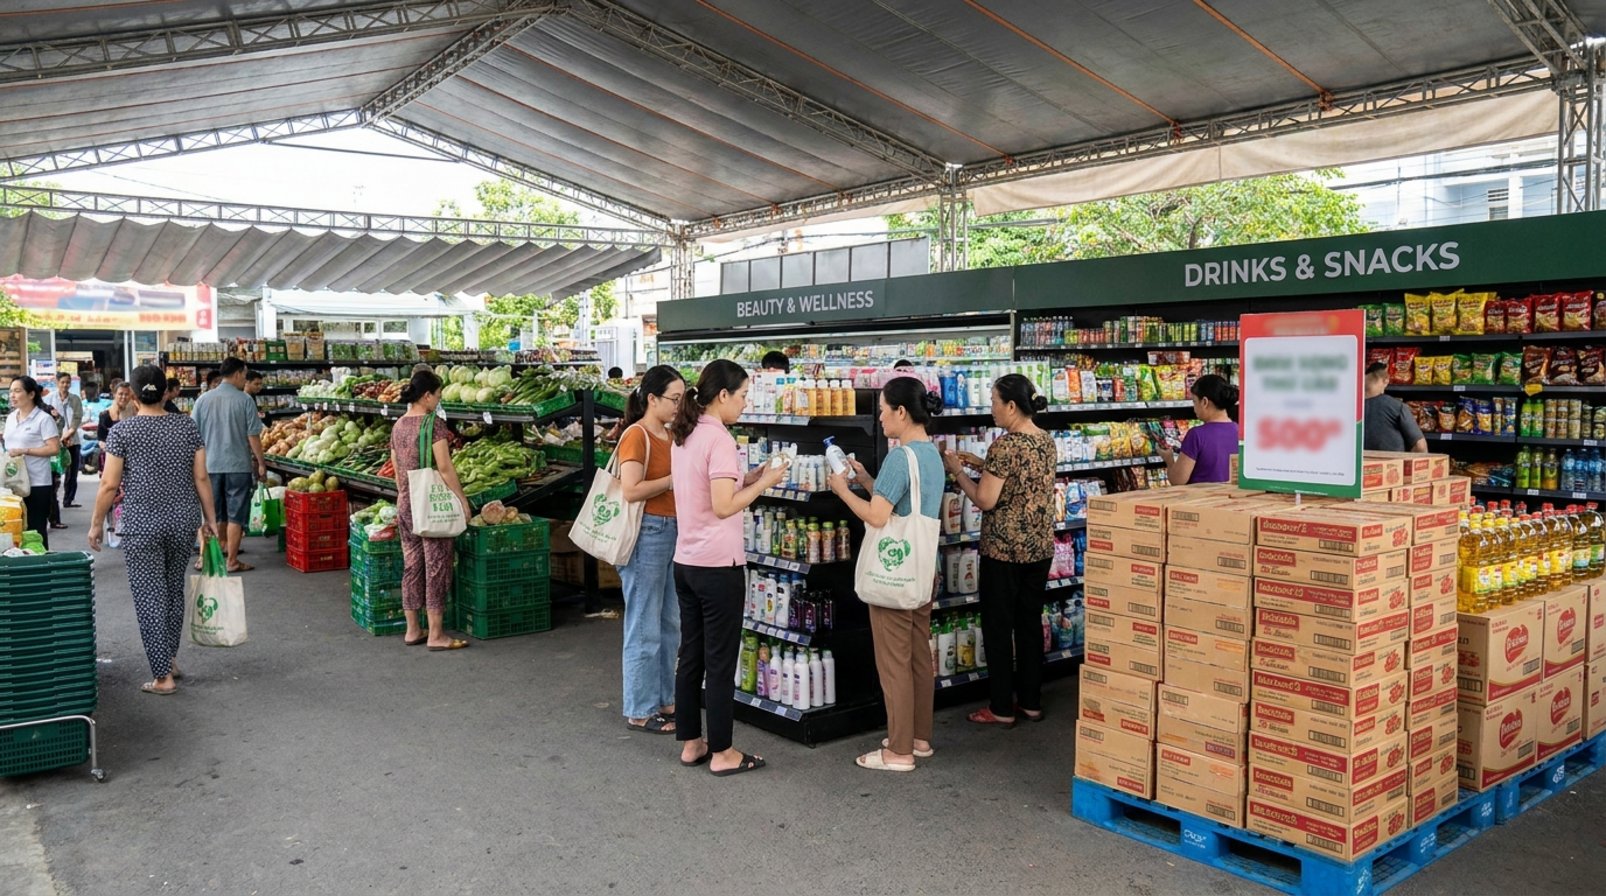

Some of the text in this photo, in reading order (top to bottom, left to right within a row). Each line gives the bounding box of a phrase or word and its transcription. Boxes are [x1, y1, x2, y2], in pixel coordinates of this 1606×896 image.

[1184, 240, 1461, 288] DRINKS & SNACKS
[736, 289, 875, 318] BEAUTY & WELLNESS
